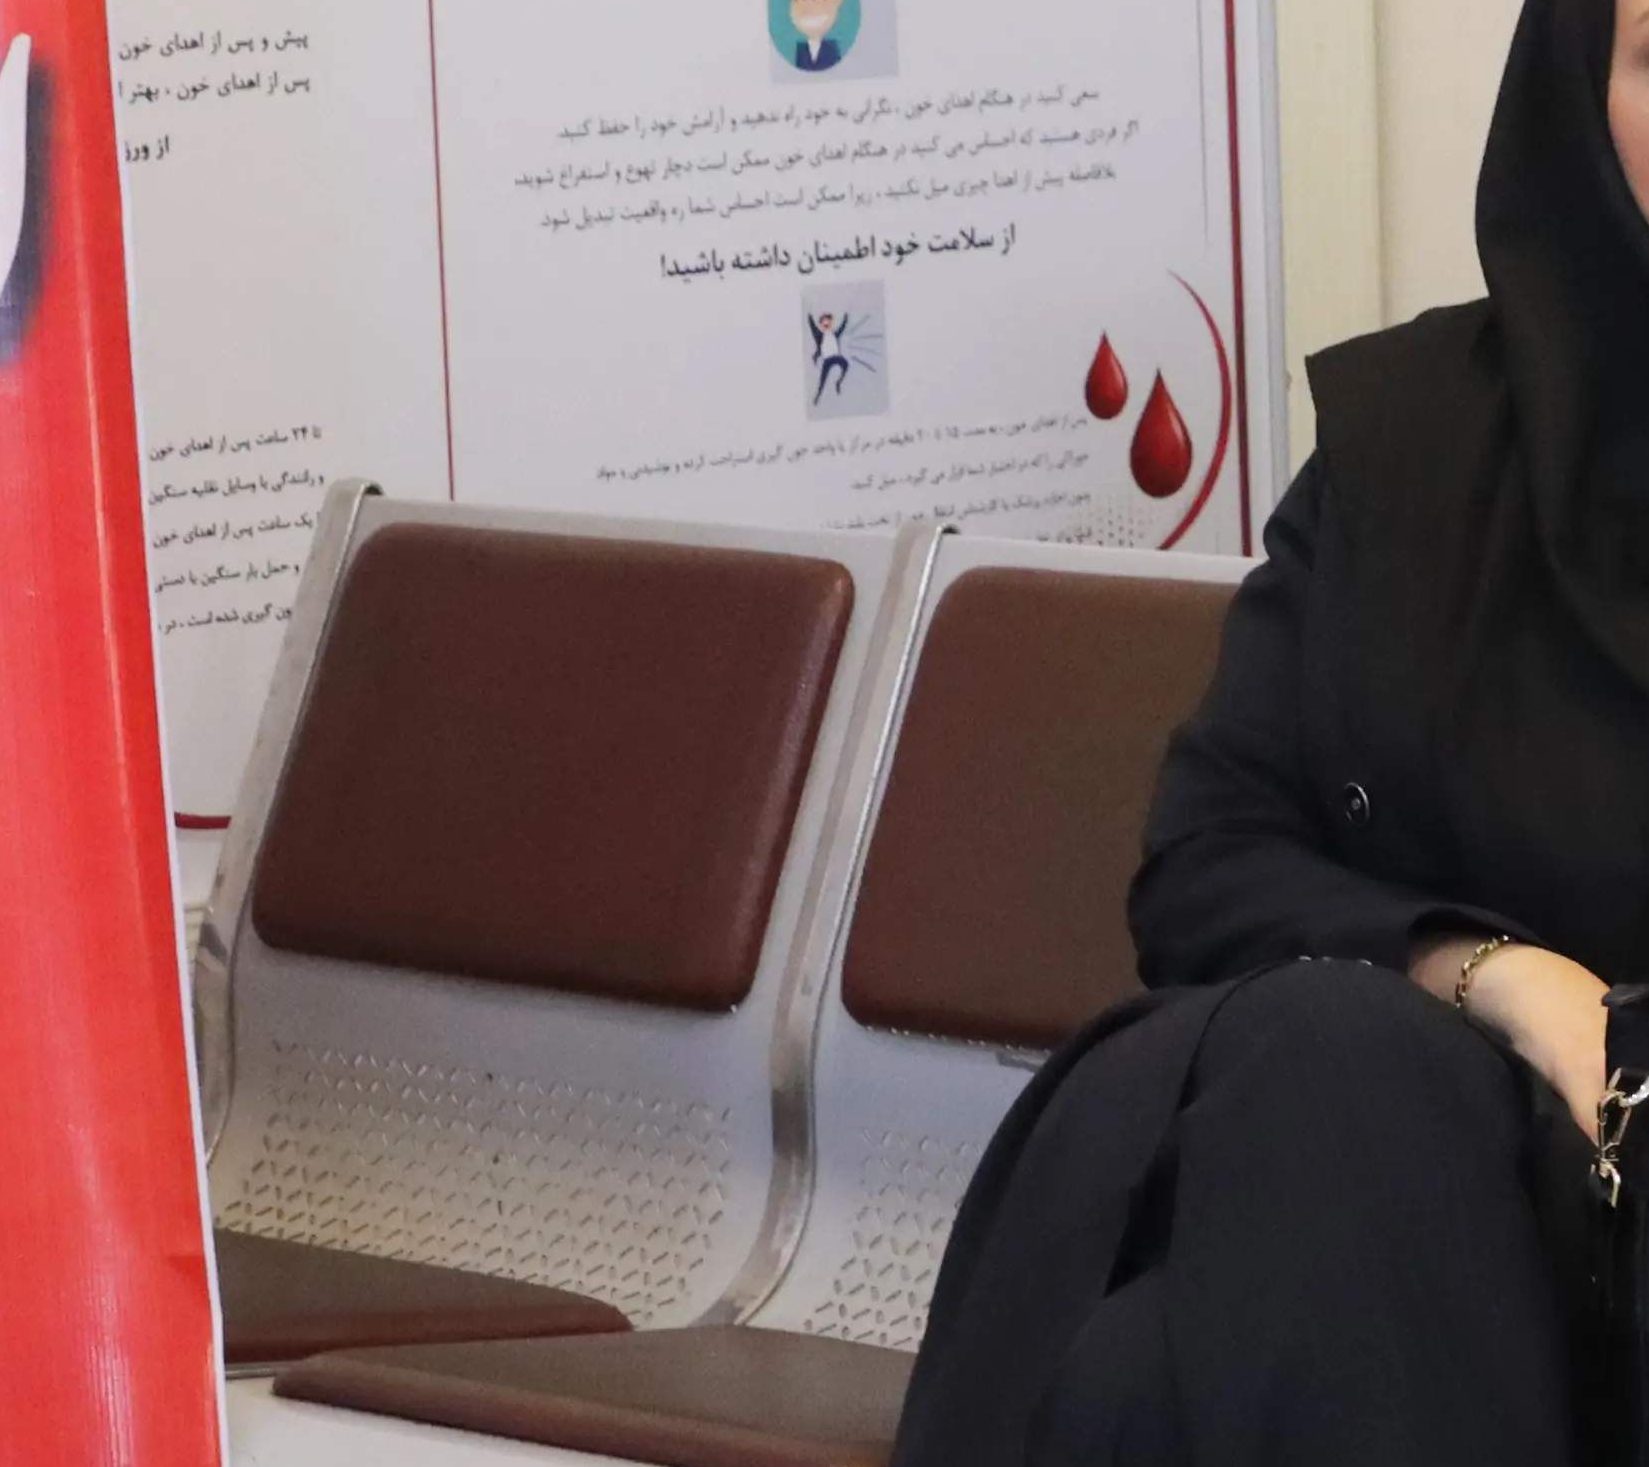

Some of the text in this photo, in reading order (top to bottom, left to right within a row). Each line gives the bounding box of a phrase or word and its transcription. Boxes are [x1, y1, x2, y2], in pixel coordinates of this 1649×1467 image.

[120, 30, 308, 60] پیش و پس از اهدای خون
[129, 84, 159, 104] بهتر
[177, 78, 210, 101] خون
[218, 72, 260, 97] اهدای
[267, 70, 277, 95] از
[284, 78, 310, 94] پس
[125, 134, 170, 162] از ورز
[881, 232, 920, 266] خود
[928, 226, 994, 254] سلامت
[1001, 223, 1015, 256] از
[731, 243, 790, 270] داشته
[798, 235, 875, 274] اطمینان
[276, 607, 292, 621] ون
